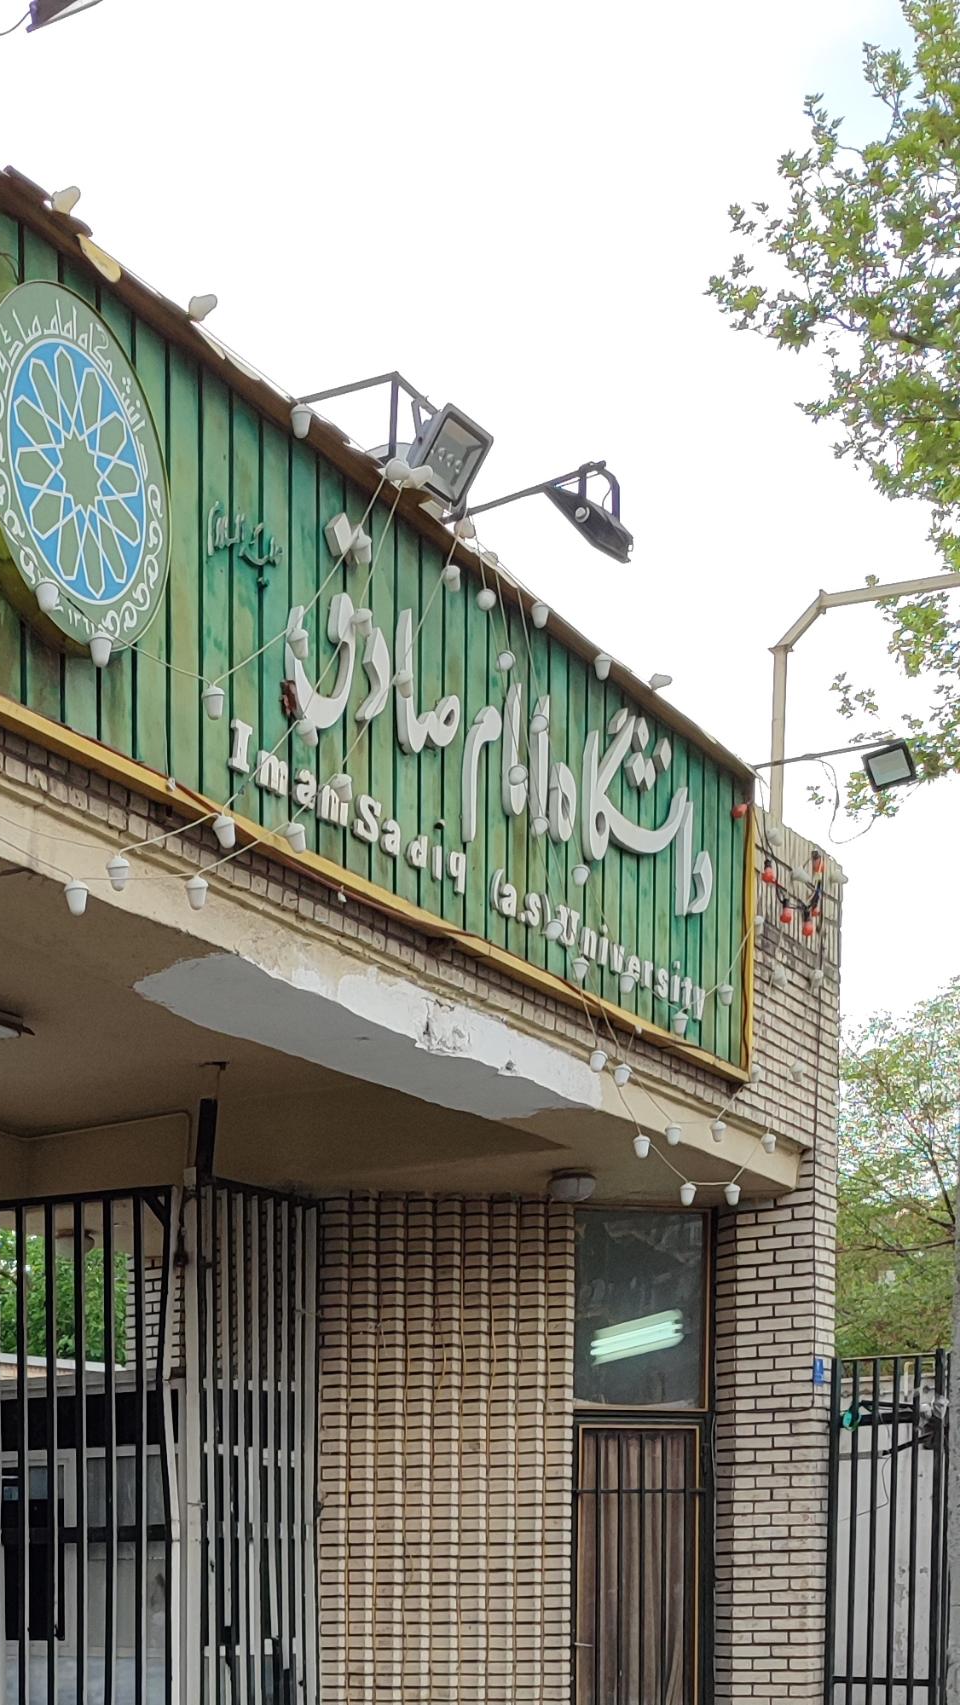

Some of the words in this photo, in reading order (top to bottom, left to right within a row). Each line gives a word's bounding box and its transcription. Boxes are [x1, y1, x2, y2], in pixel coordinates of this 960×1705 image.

[284, 513, 461, 755] صادق
[228, 718, 349, 828] Imam
[353, 793, 467, 895] Sadiq
[556, 904, 706, 1021] University
[461, 683, 549, 842] امام
[548, 708, 713, 917] دانشگاه
